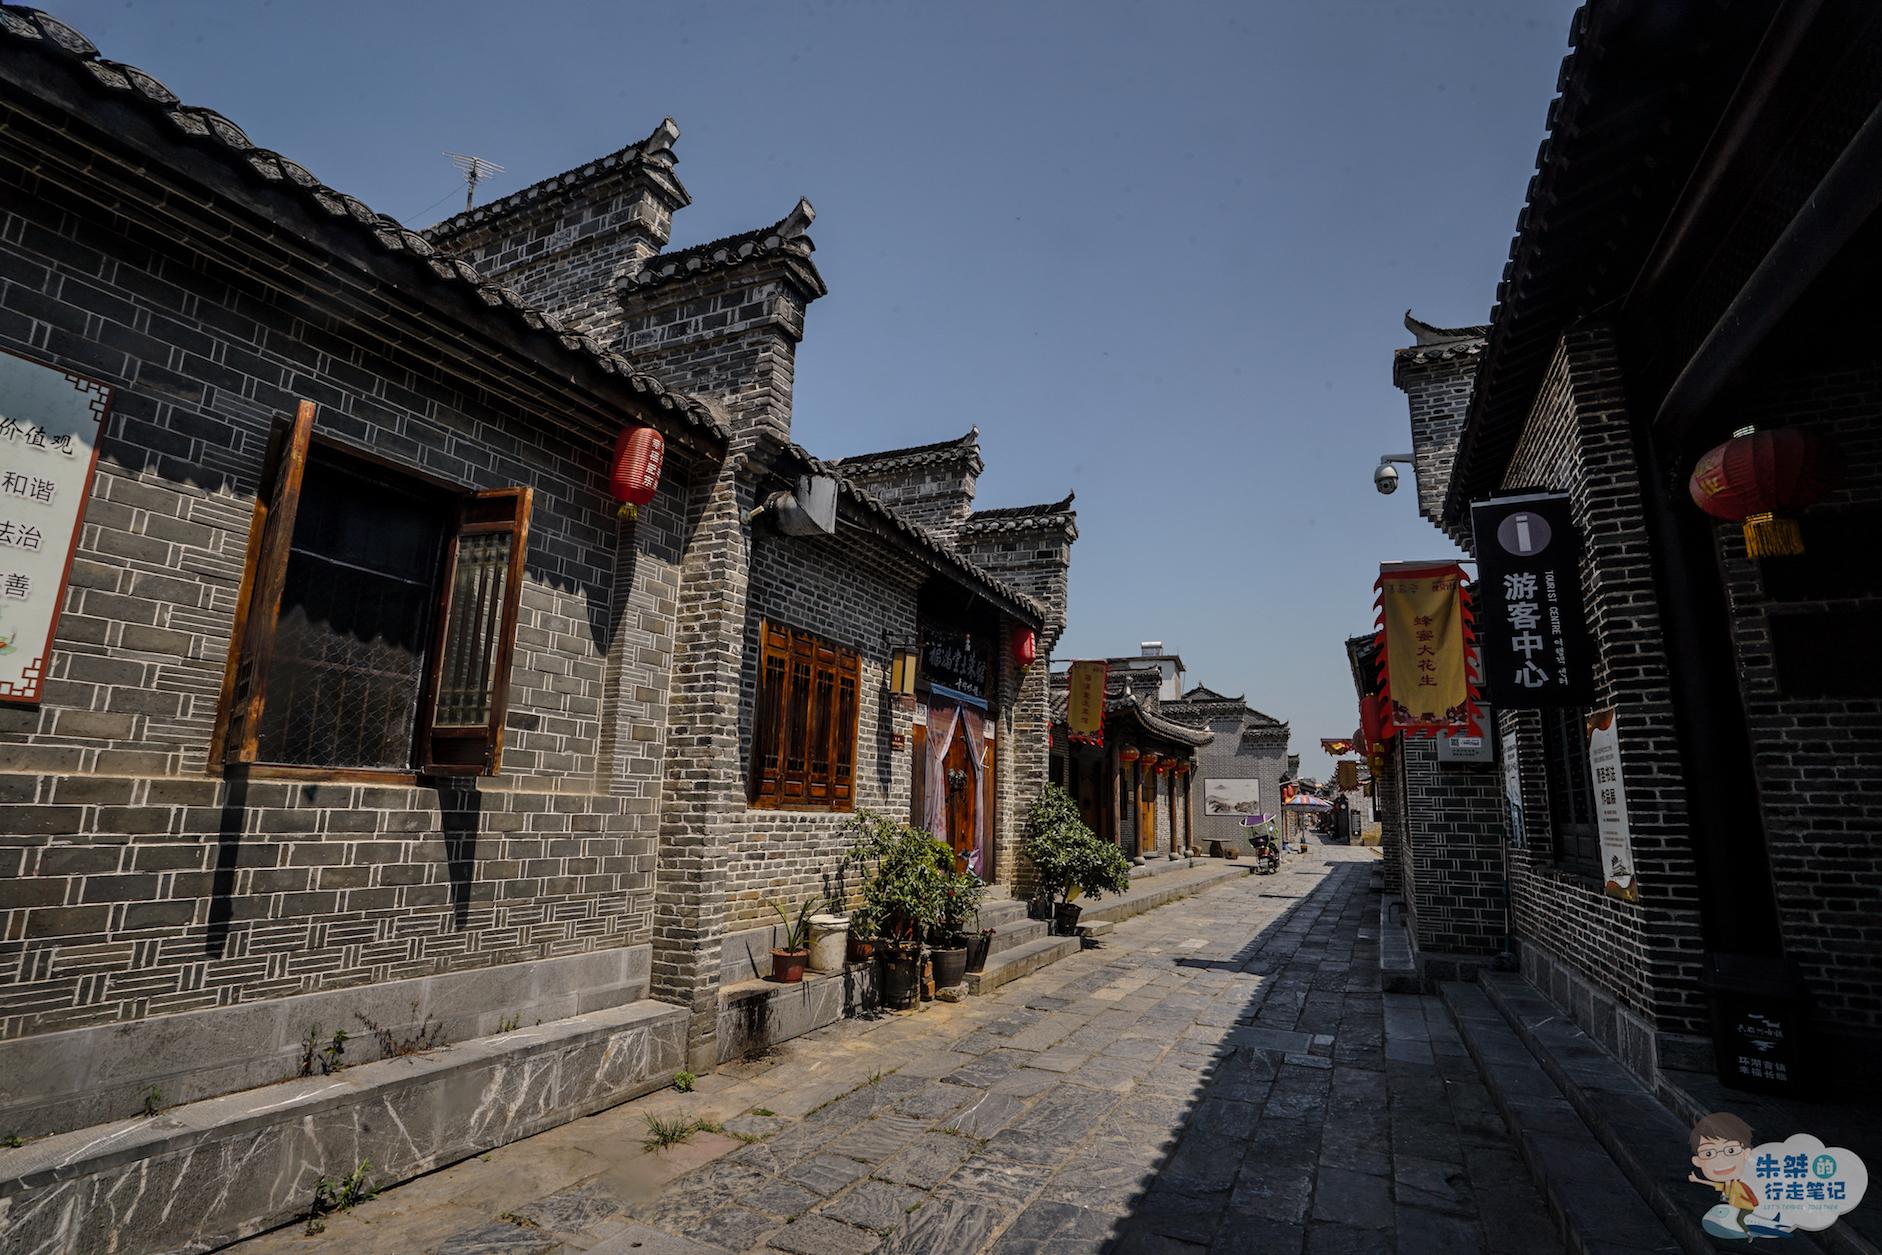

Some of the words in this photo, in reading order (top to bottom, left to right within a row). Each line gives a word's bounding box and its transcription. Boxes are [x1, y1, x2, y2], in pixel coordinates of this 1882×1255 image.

[0, 417, 73, 456] 价值观
[2, 471, 55, 502] 和谐
[0, 572, 30, 598] 善
[1544, 569, 1558, 603] TOURIST
[1503, 571, 1550, 689] 游客中心
[1549, 605, 1562, 636] CENTRE
[1413, 615, 1438, 687] 蜂蜜大花生
